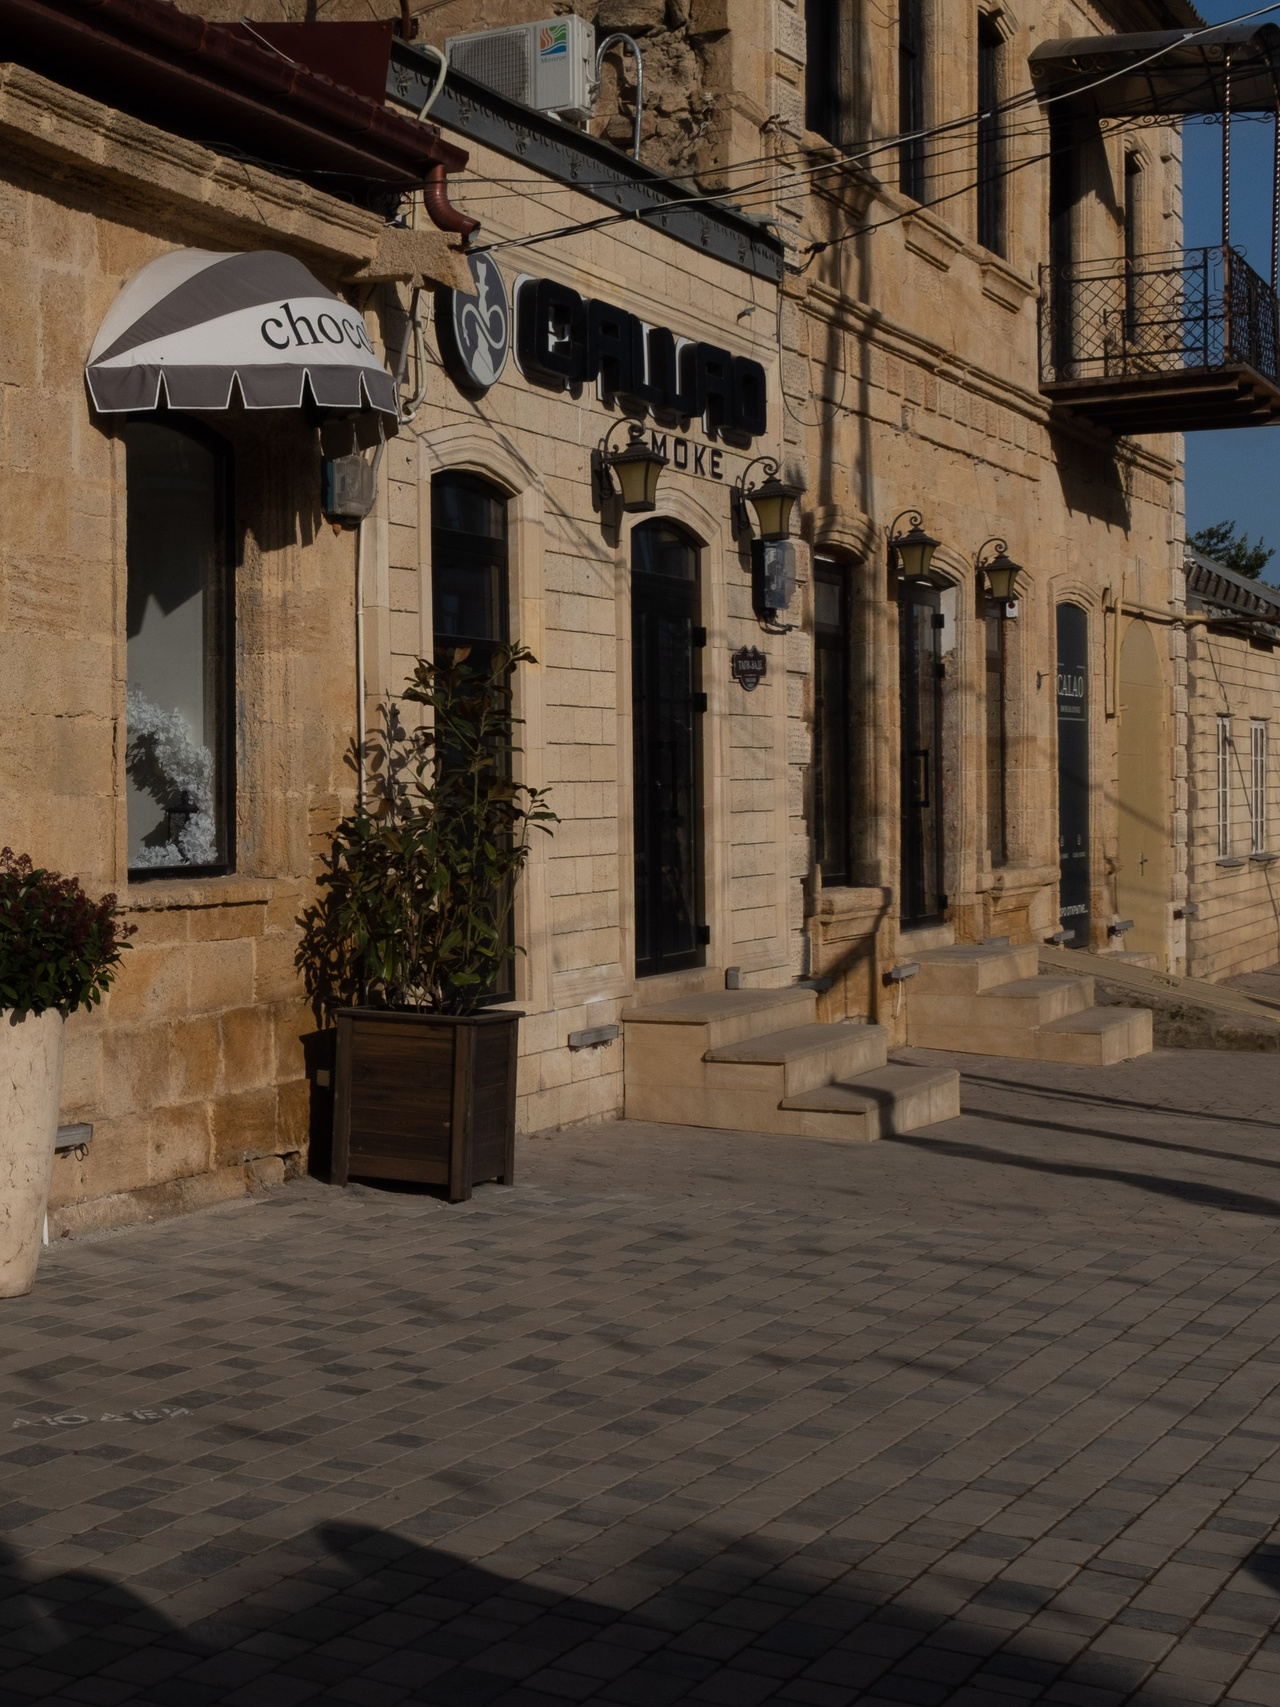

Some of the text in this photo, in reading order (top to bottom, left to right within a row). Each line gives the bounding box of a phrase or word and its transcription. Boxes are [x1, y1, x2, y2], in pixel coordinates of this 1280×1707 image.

[540, 55, 567, 64] Monroe
[261, 303, 375, 355] choco
[651, 431, 723, 480] MOKE
